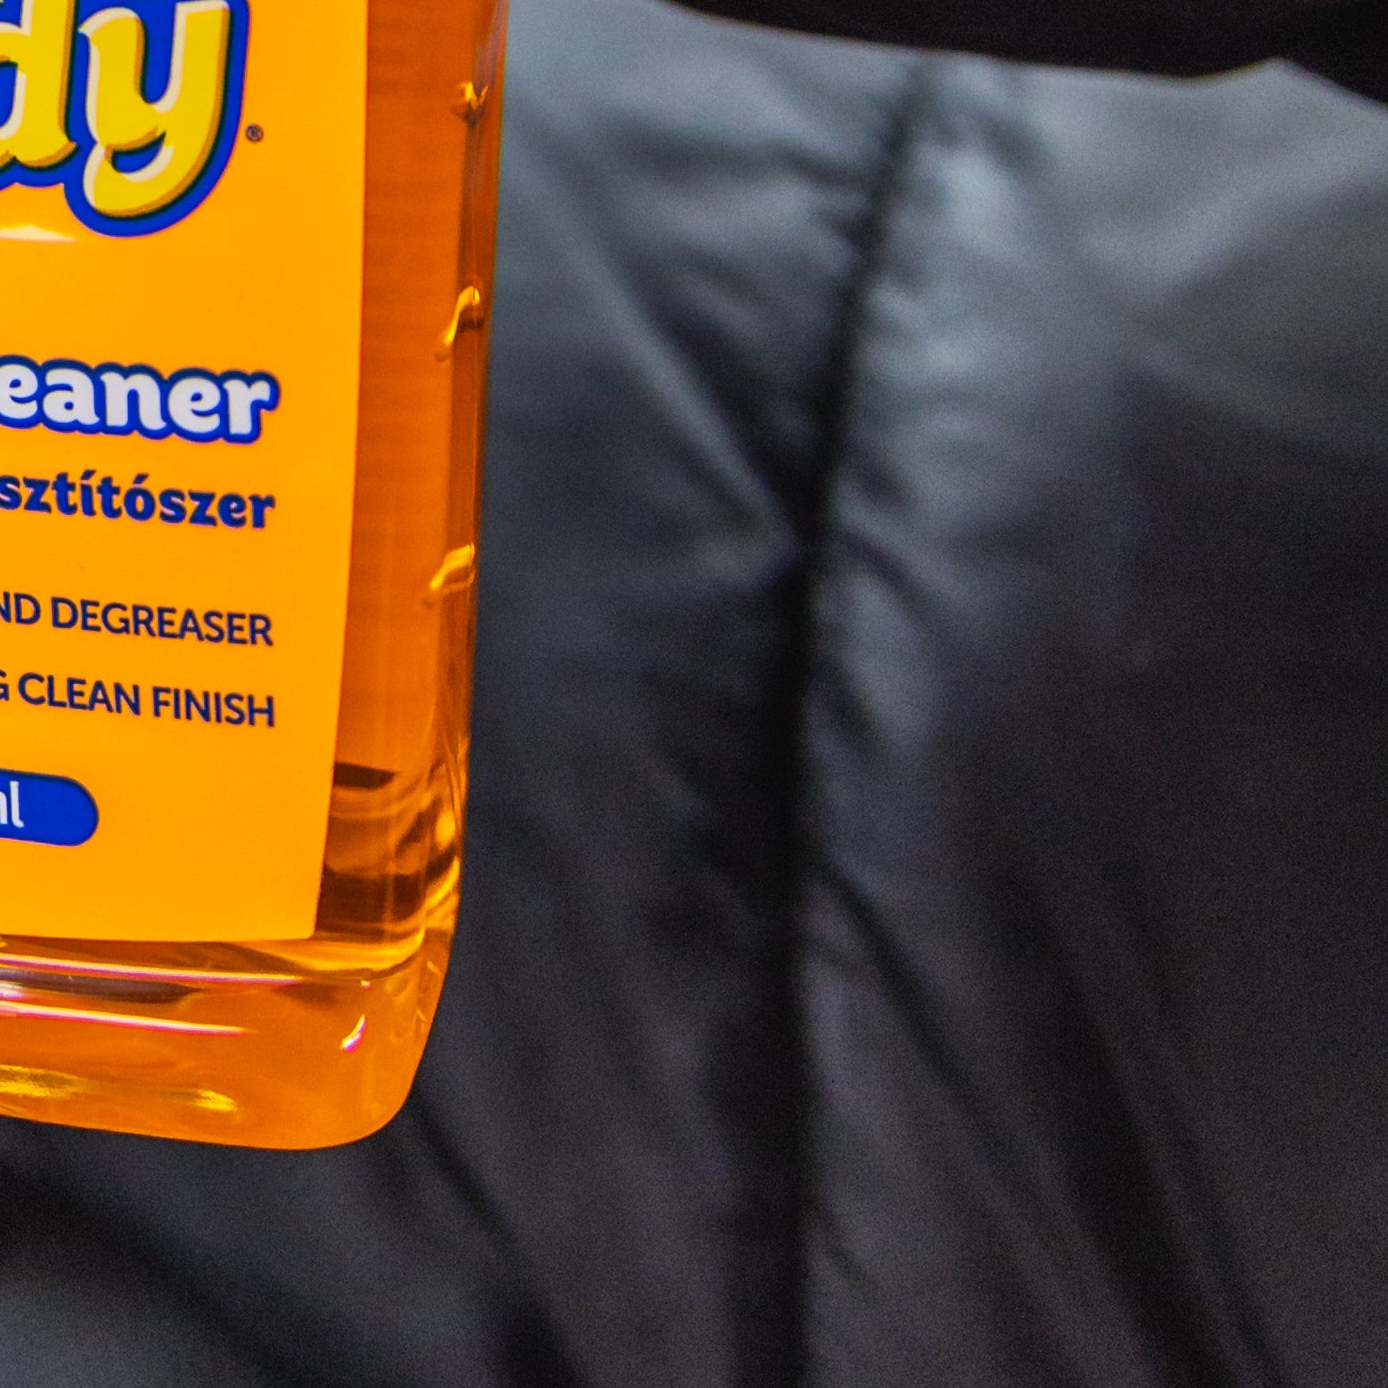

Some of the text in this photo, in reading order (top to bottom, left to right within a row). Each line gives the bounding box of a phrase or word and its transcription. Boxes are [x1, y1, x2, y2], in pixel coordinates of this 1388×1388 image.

[50, 595, 274, 648] DEGREASER
[18, 671, 140, 717] CLEAN
[151, 687, 276, 729] FINISH
